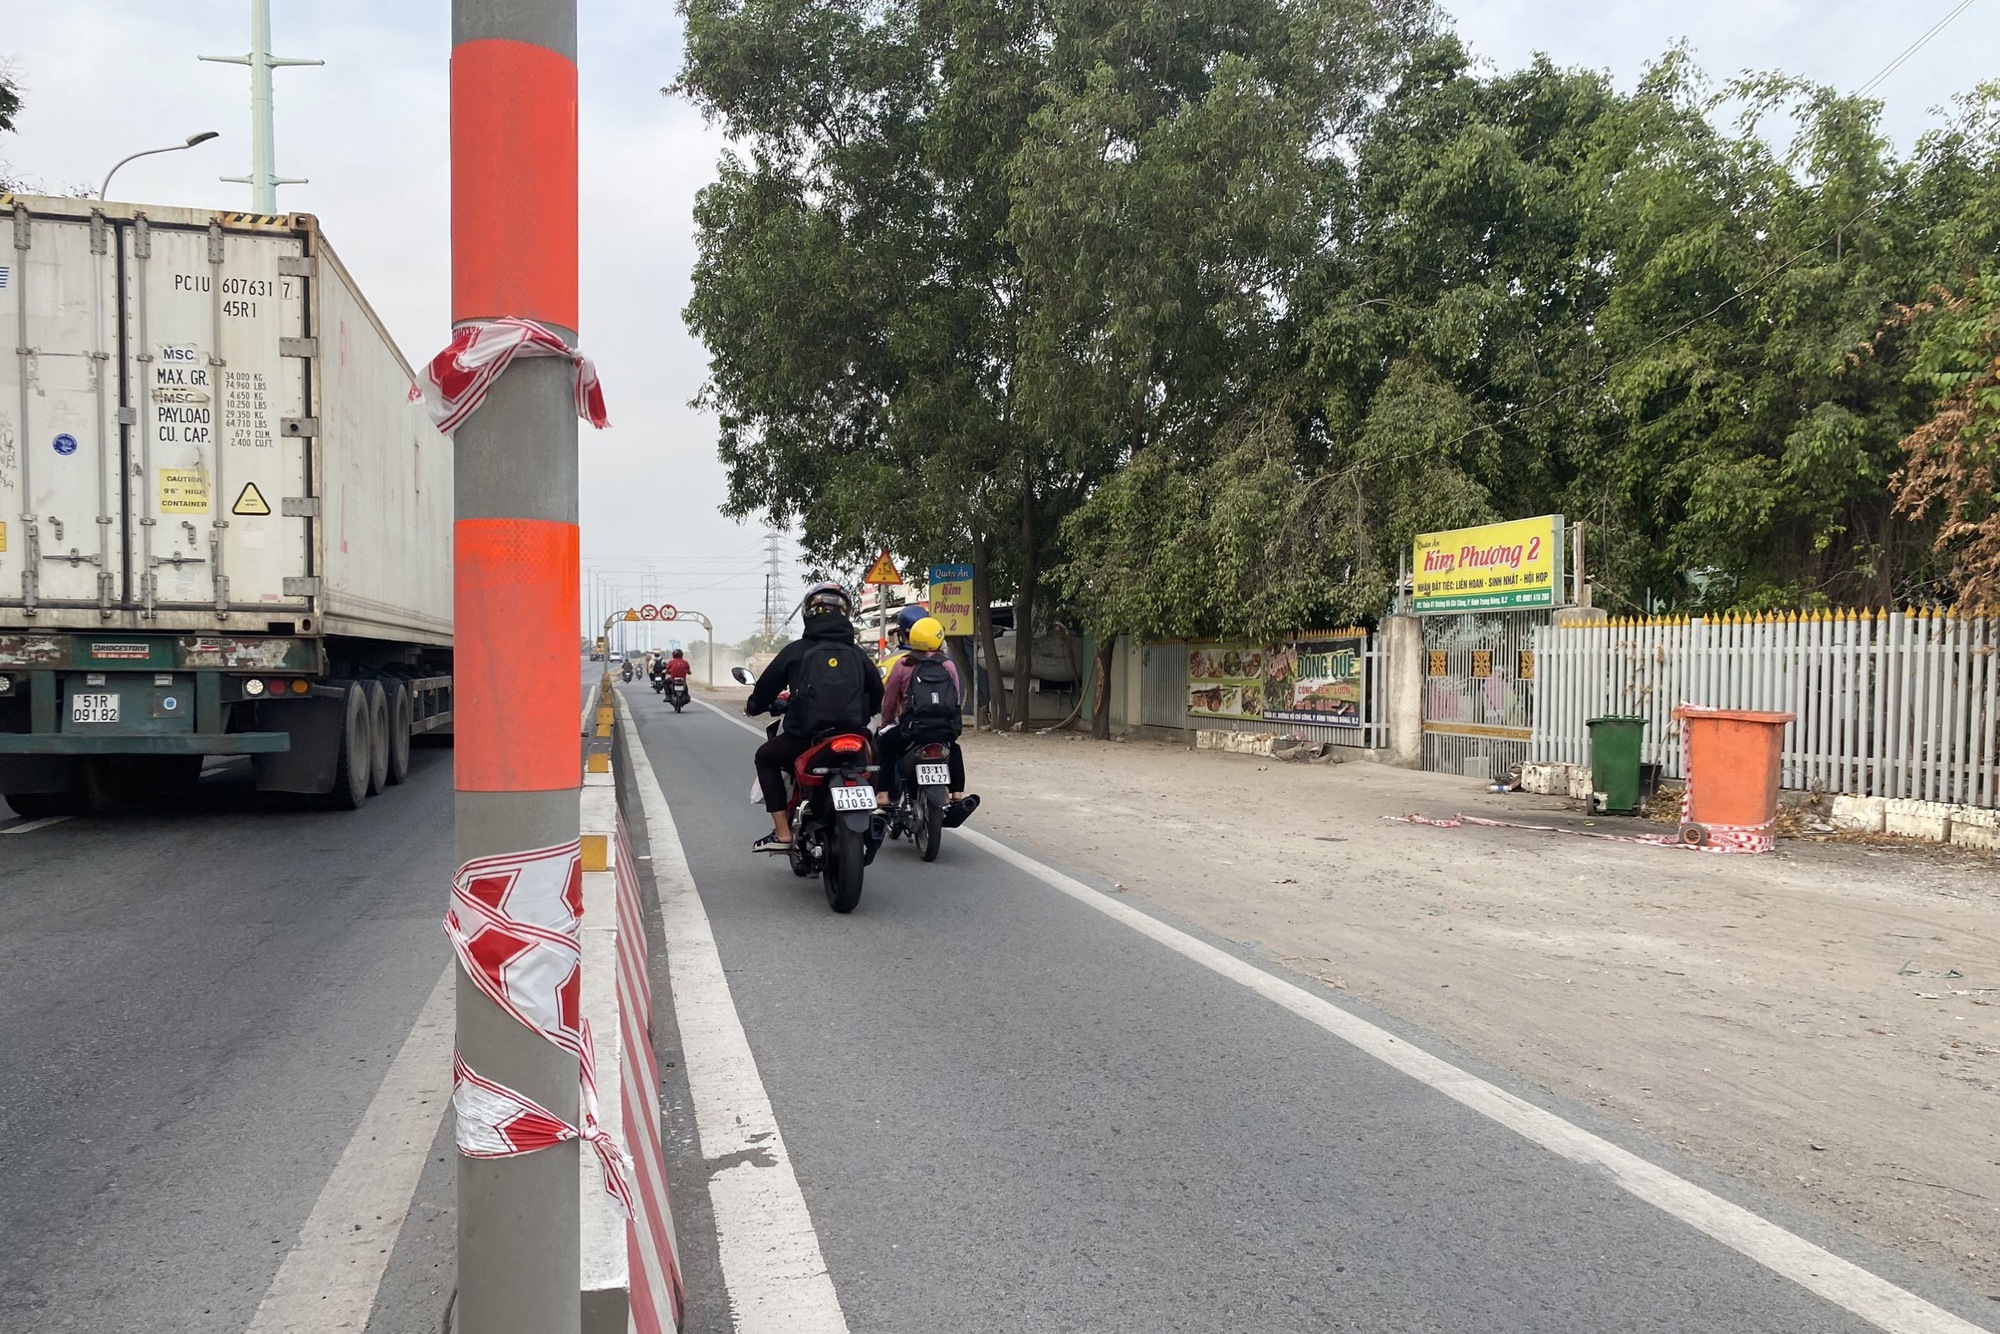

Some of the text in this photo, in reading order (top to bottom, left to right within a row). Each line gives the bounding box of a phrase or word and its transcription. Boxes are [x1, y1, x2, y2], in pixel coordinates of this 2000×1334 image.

[175, 274, 290, 298] PCIU 607631 7
[223, 301, 256, 318] 45R1
[164, 349, 194, 360] MSC
[157, 368, 210, 386] MAX. GR.
[254, 374, 263, 382] KG
[254, 382, 266, 390] LBS
[254, 392, 263, 400] KG
[254, 401, 267, 410] LBS
[158, 406, 210, 424] PAYLOAD
[254, 411, 264, 420] KG
[254, 420, 267, 428] LBS
[159, 426, 211, 444] CU. CAP.
[1424, 536, 1540, 572] Kim Phượng 2
[1488, 576, 1502, 587] SINH
[942, 583, 962, 596] Kim
[950, 618, 957, 632] 2
[83, 695, 108, 708] 51R
[74, 708, 117, 722] 091.82
[921, 766, 944, 774] 83-X1
[920, 774, 948, 784] 194.27
[838, 788, 868, 799] 71-G1
[836, 798, 874, 810] 010.63
